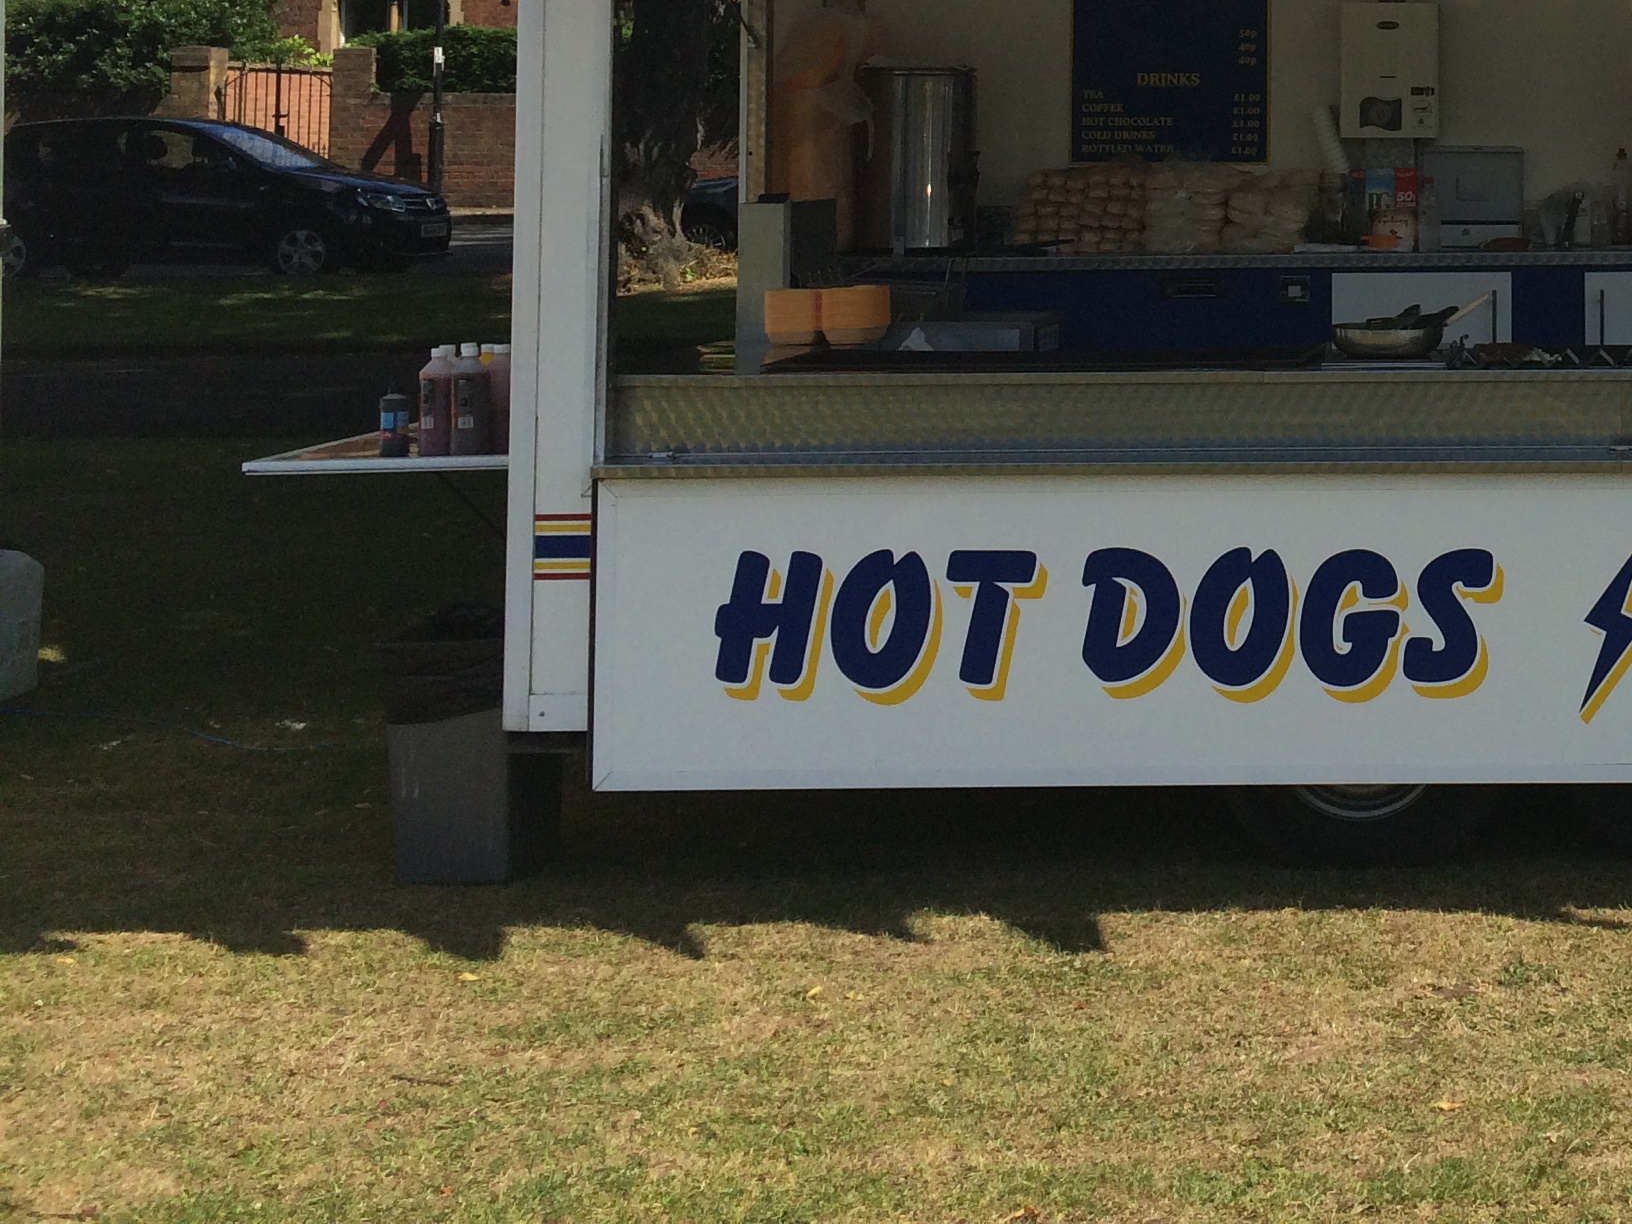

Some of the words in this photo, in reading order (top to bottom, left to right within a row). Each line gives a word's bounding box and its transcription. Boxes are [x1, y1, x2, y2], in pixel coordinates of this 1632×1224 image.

[1136, 73, 1200, 87] DRINKS
[1083, 90, 1104, 99] TEA
[1082, 103, 1124, 113] COFFEE
[1082, 117, 1105, 126] HOT
[1107, 117, 1174, 126] CHOCOLATE
[1082, 131, 1112, 140] COLD
[1114, 131, 1156, 140] DRINKS
[714, 546, 1048, 707] HOT
[1080, 545, 1505, 705] DOGS
